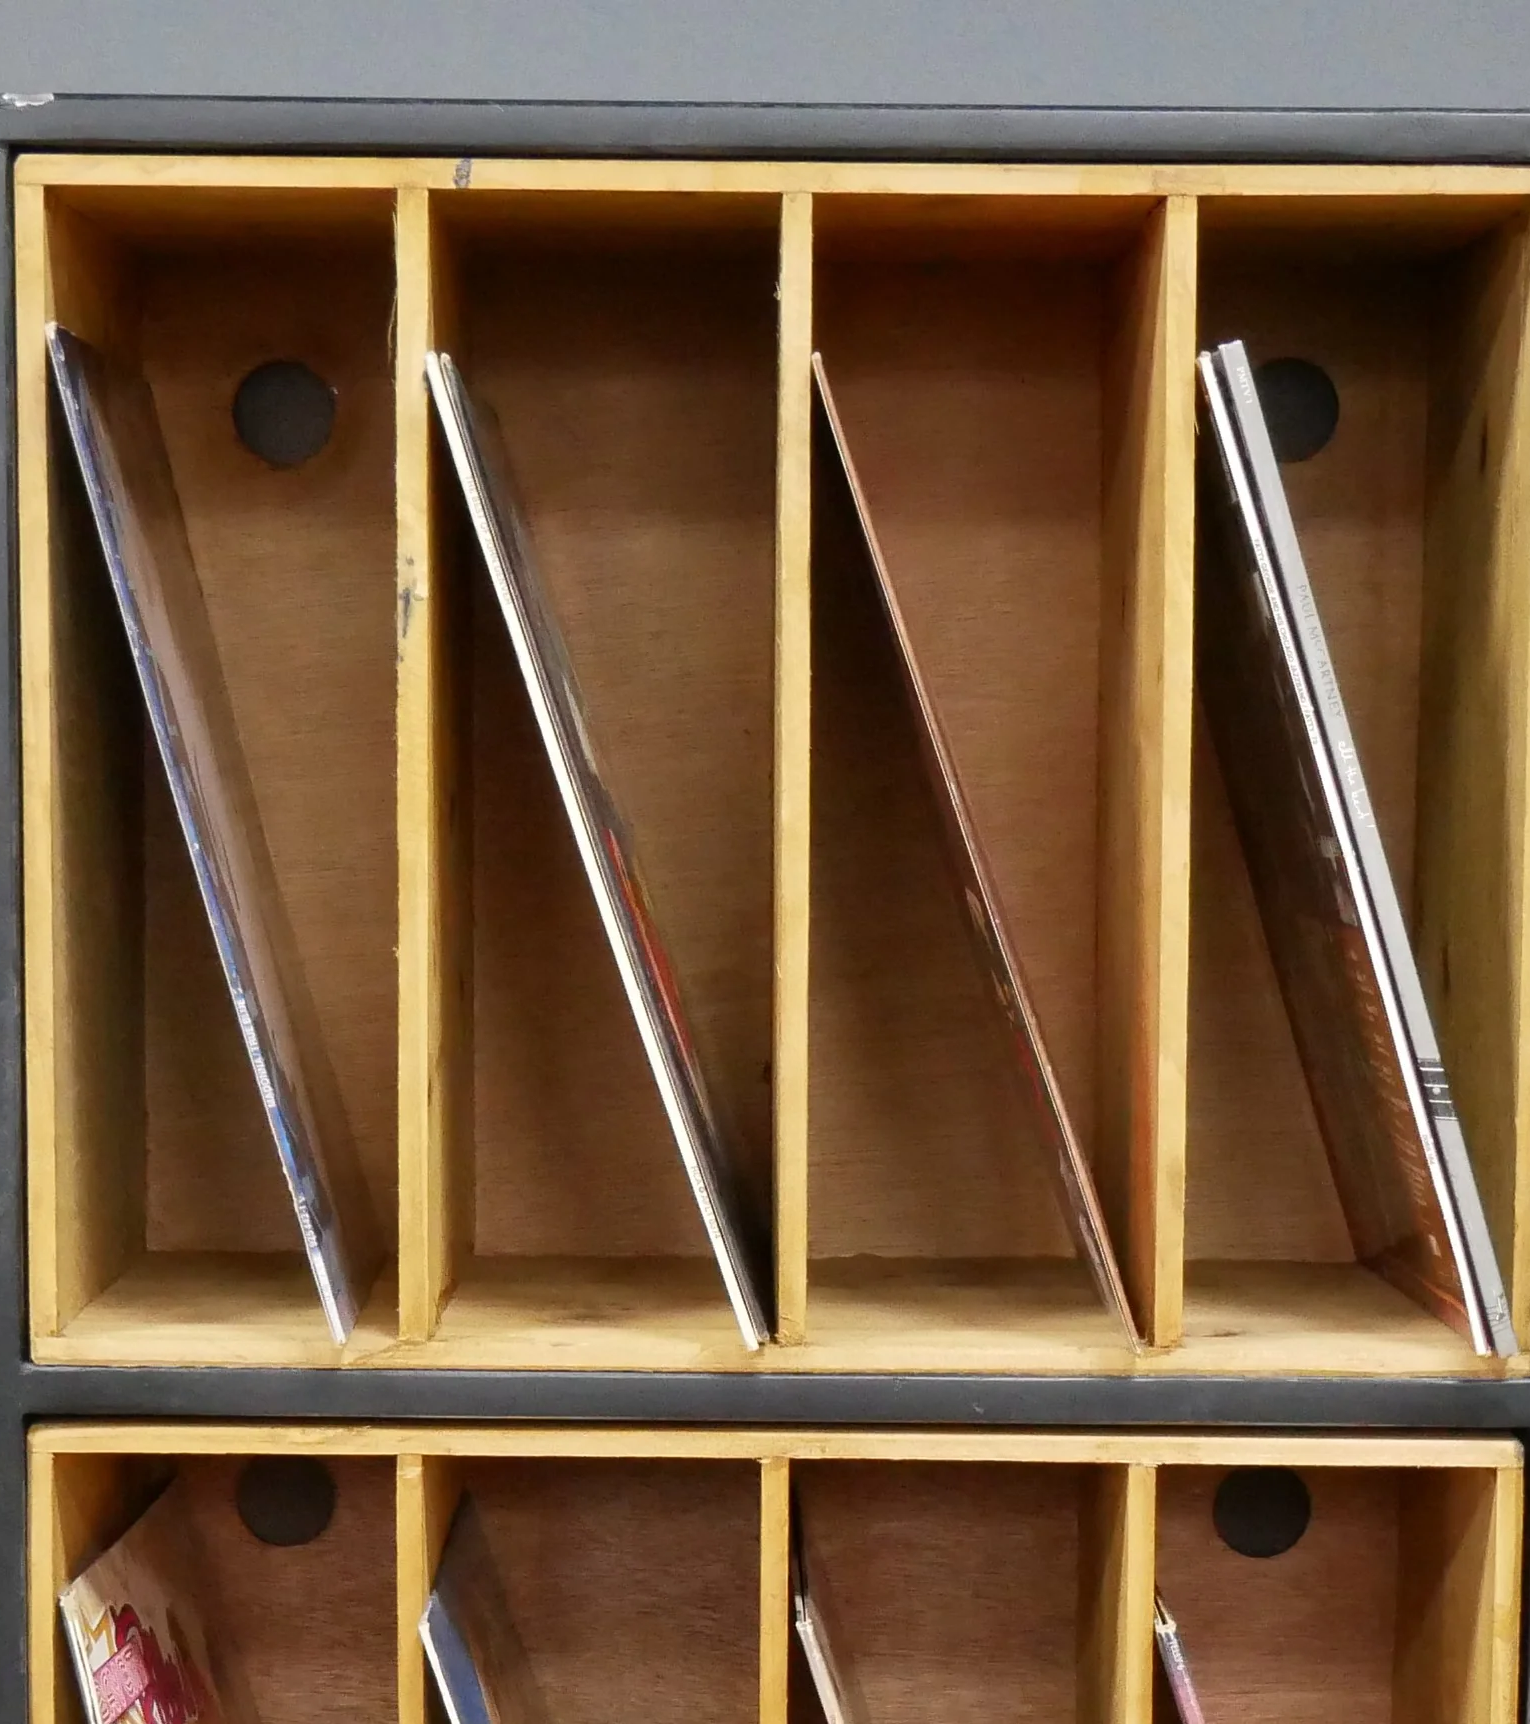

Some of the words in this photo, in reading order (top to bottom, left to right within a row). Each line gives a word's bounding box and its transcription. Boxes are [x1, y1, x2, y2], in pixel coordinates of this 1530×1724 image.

[1236, 366, 1251, 396] PMTV
[472, 496, 484, 518] BEST
[1254, 538, 1264, 560] FATTY
[1261, 562, 1273, 593] GEORGE
[1296, 583, 1315, 620] PAUL
